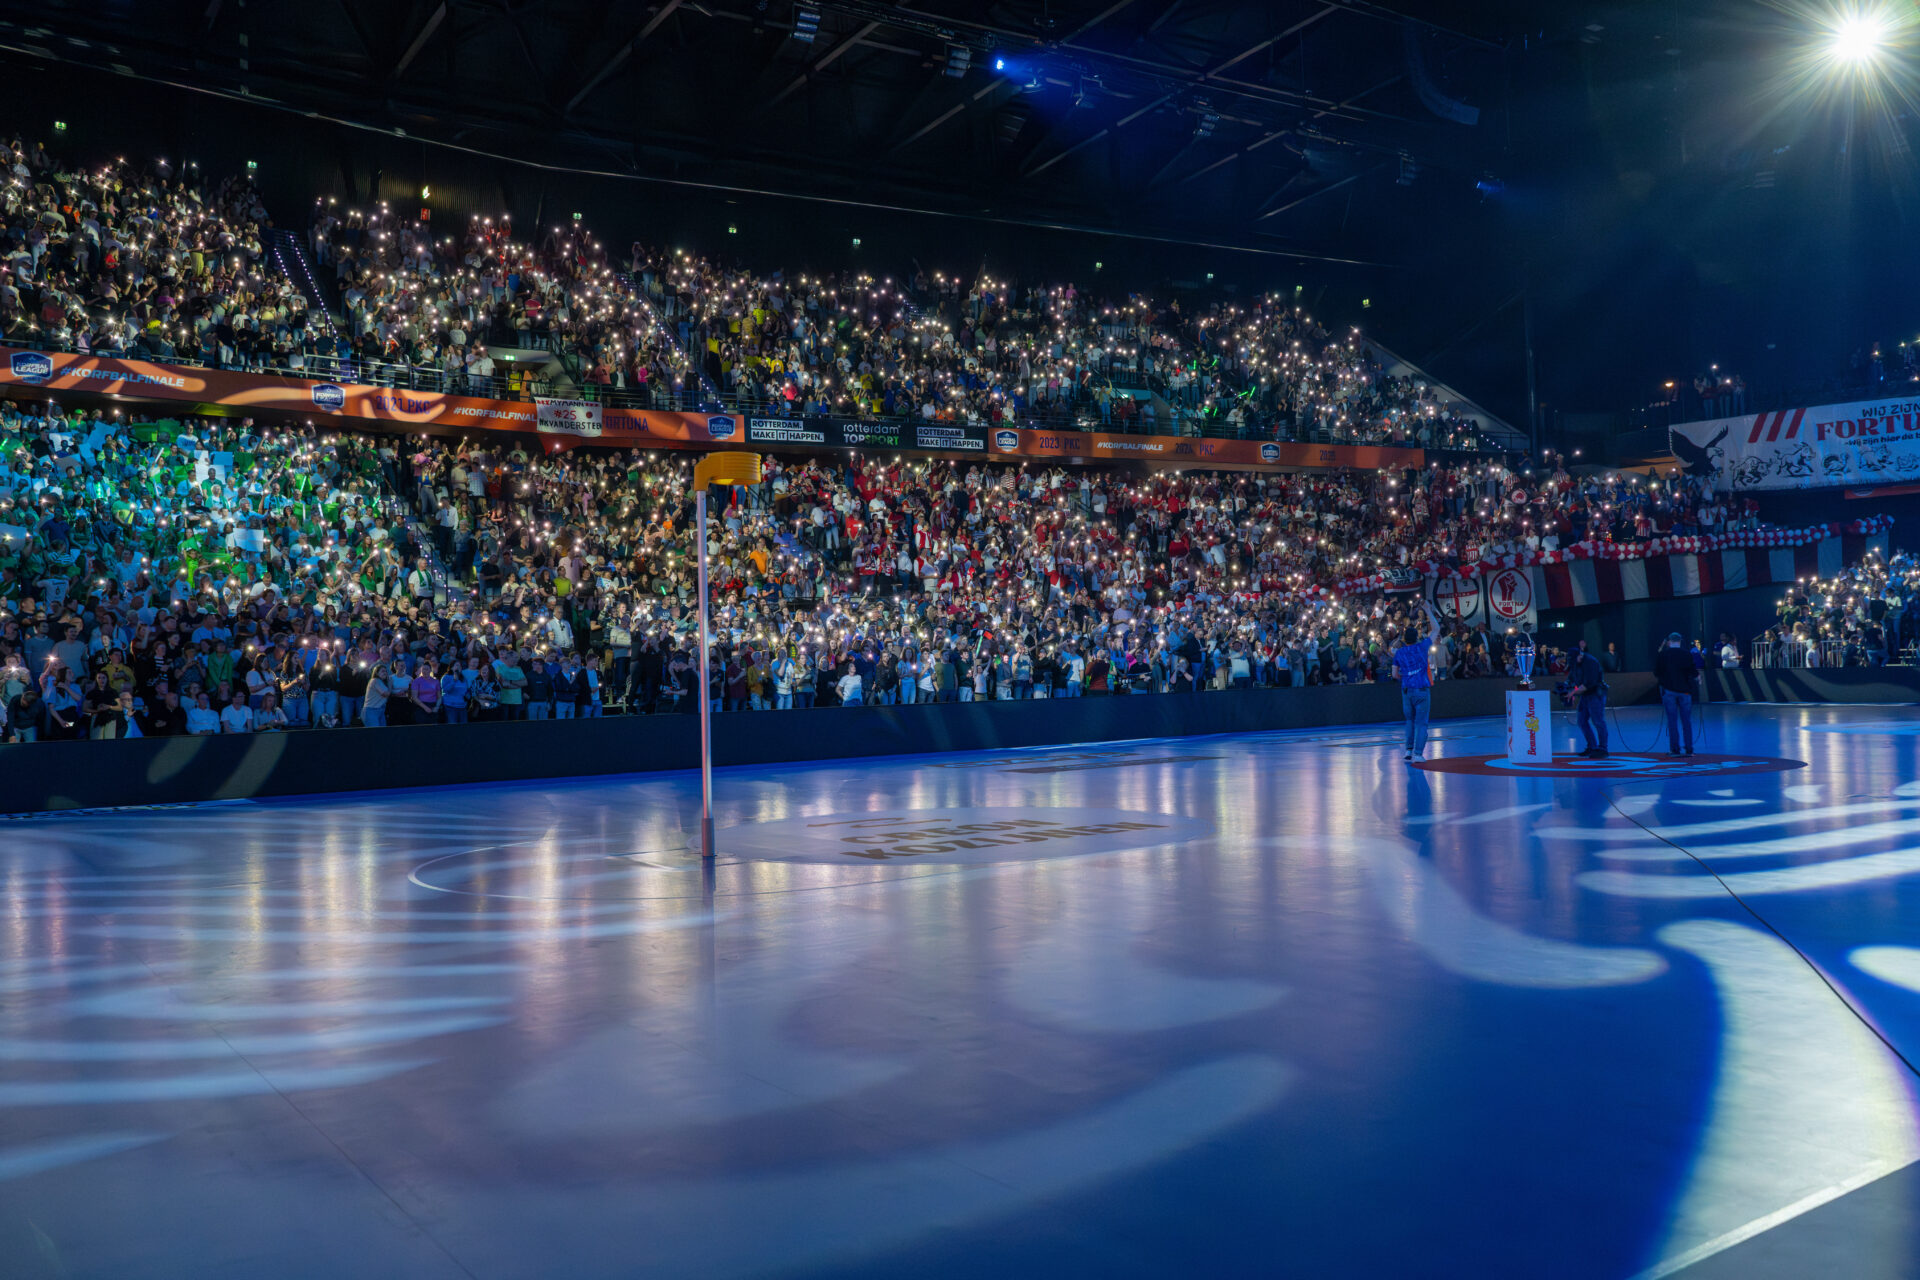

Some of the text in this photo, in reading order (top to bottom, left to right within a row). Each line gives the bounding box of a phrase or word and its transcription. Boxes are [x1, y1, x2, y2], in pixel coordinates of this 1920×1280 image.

[60, 366, 185, 387] #KORFBALFINALE
[376, 396, 432, 414] 2021 PKC
[1862, 402, 1920, 417] WIJ ZIJN
[453, 407, 537, 422] #KORFBALFINAL
[553, 409, 577, 421] #25
[752, 420, 802, 429] ROTTERDAM.
[843, 424, 901, 434] rotterdam
[752, 431, 823, 441] MAKE IT HAPPEN.
[918, 429, 963, 437] ROTTERDAM.
[843, 434, 900, 446] TOPSPORT
[918, 438, 982, 448] MAKE IT HAPPEN.
[1039, 437, 1081, 450] 2023 PKC
[1097, 441, 1164, 451] #KORFBALFINALE
[1199, 444, 1215, 456] PKC
[840, 819, 1062, 844] CREON
[840, 822, 1169, 860] KOZIJNEN
